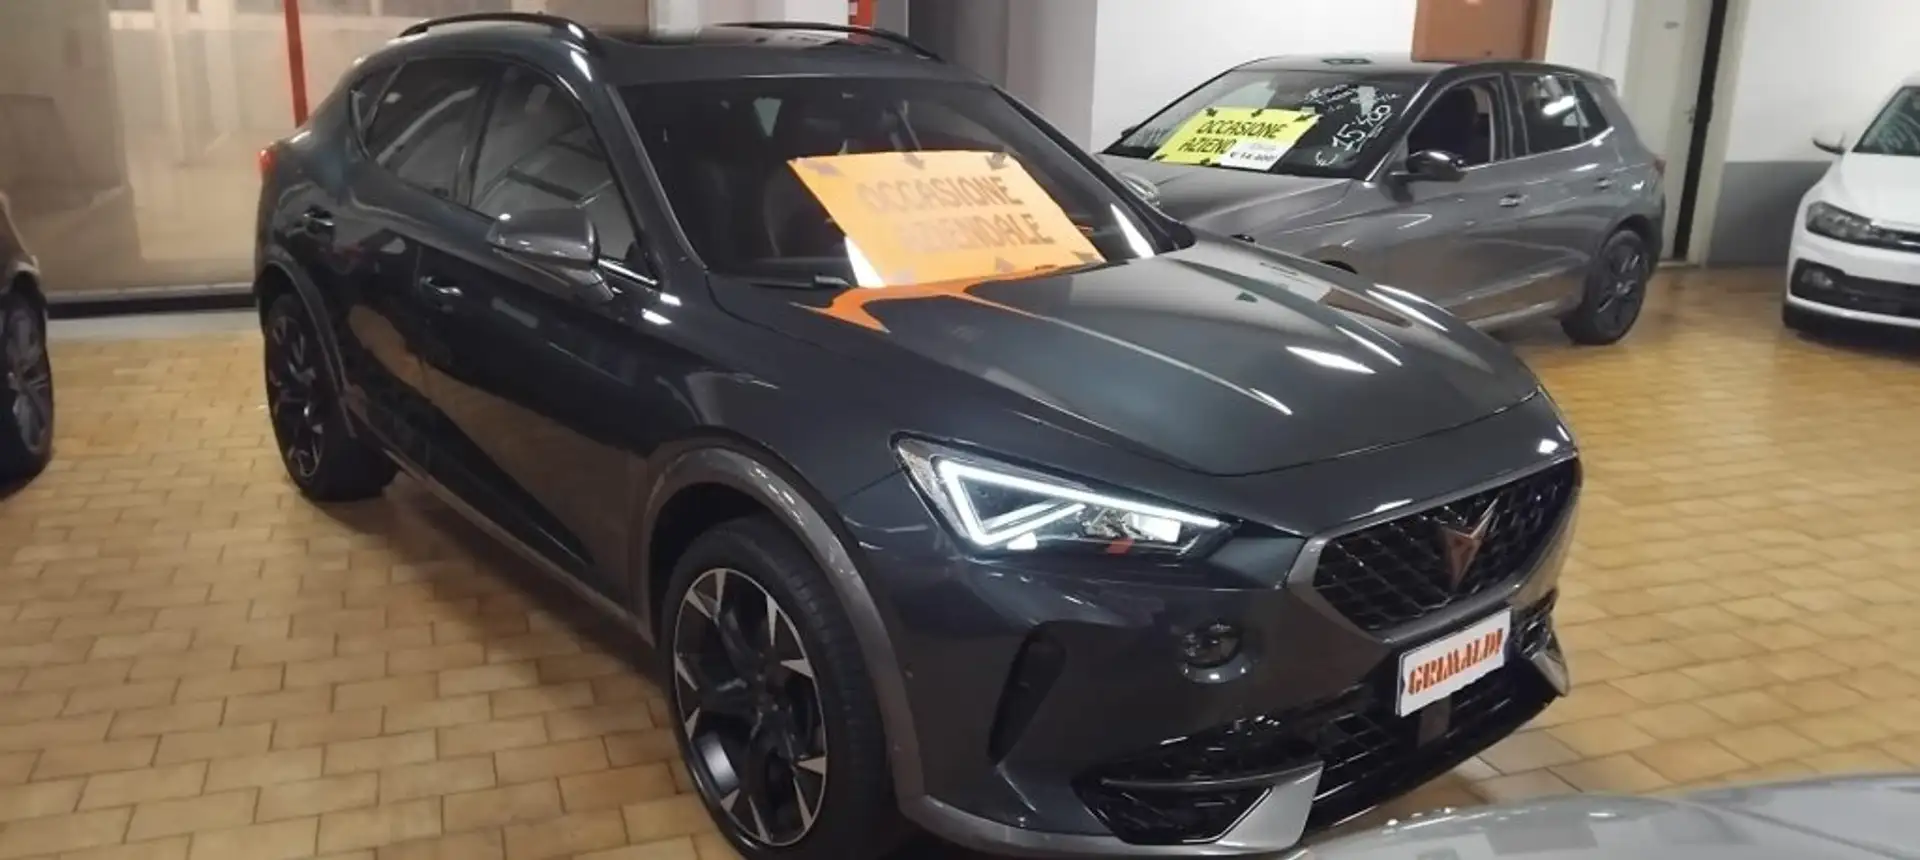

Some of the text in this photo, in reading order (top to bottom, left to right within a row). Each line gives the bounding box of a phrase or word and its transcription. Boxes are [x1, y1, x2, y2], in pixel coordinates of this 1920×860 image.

[1196, 120, 1288, 139] OCCASIONE
[856, 175, 1025, 213] OCCASIONE
[892, 212, 1058, 252] ZIENDALE
[1407, 627, 1504, 695] GRIMALDI
